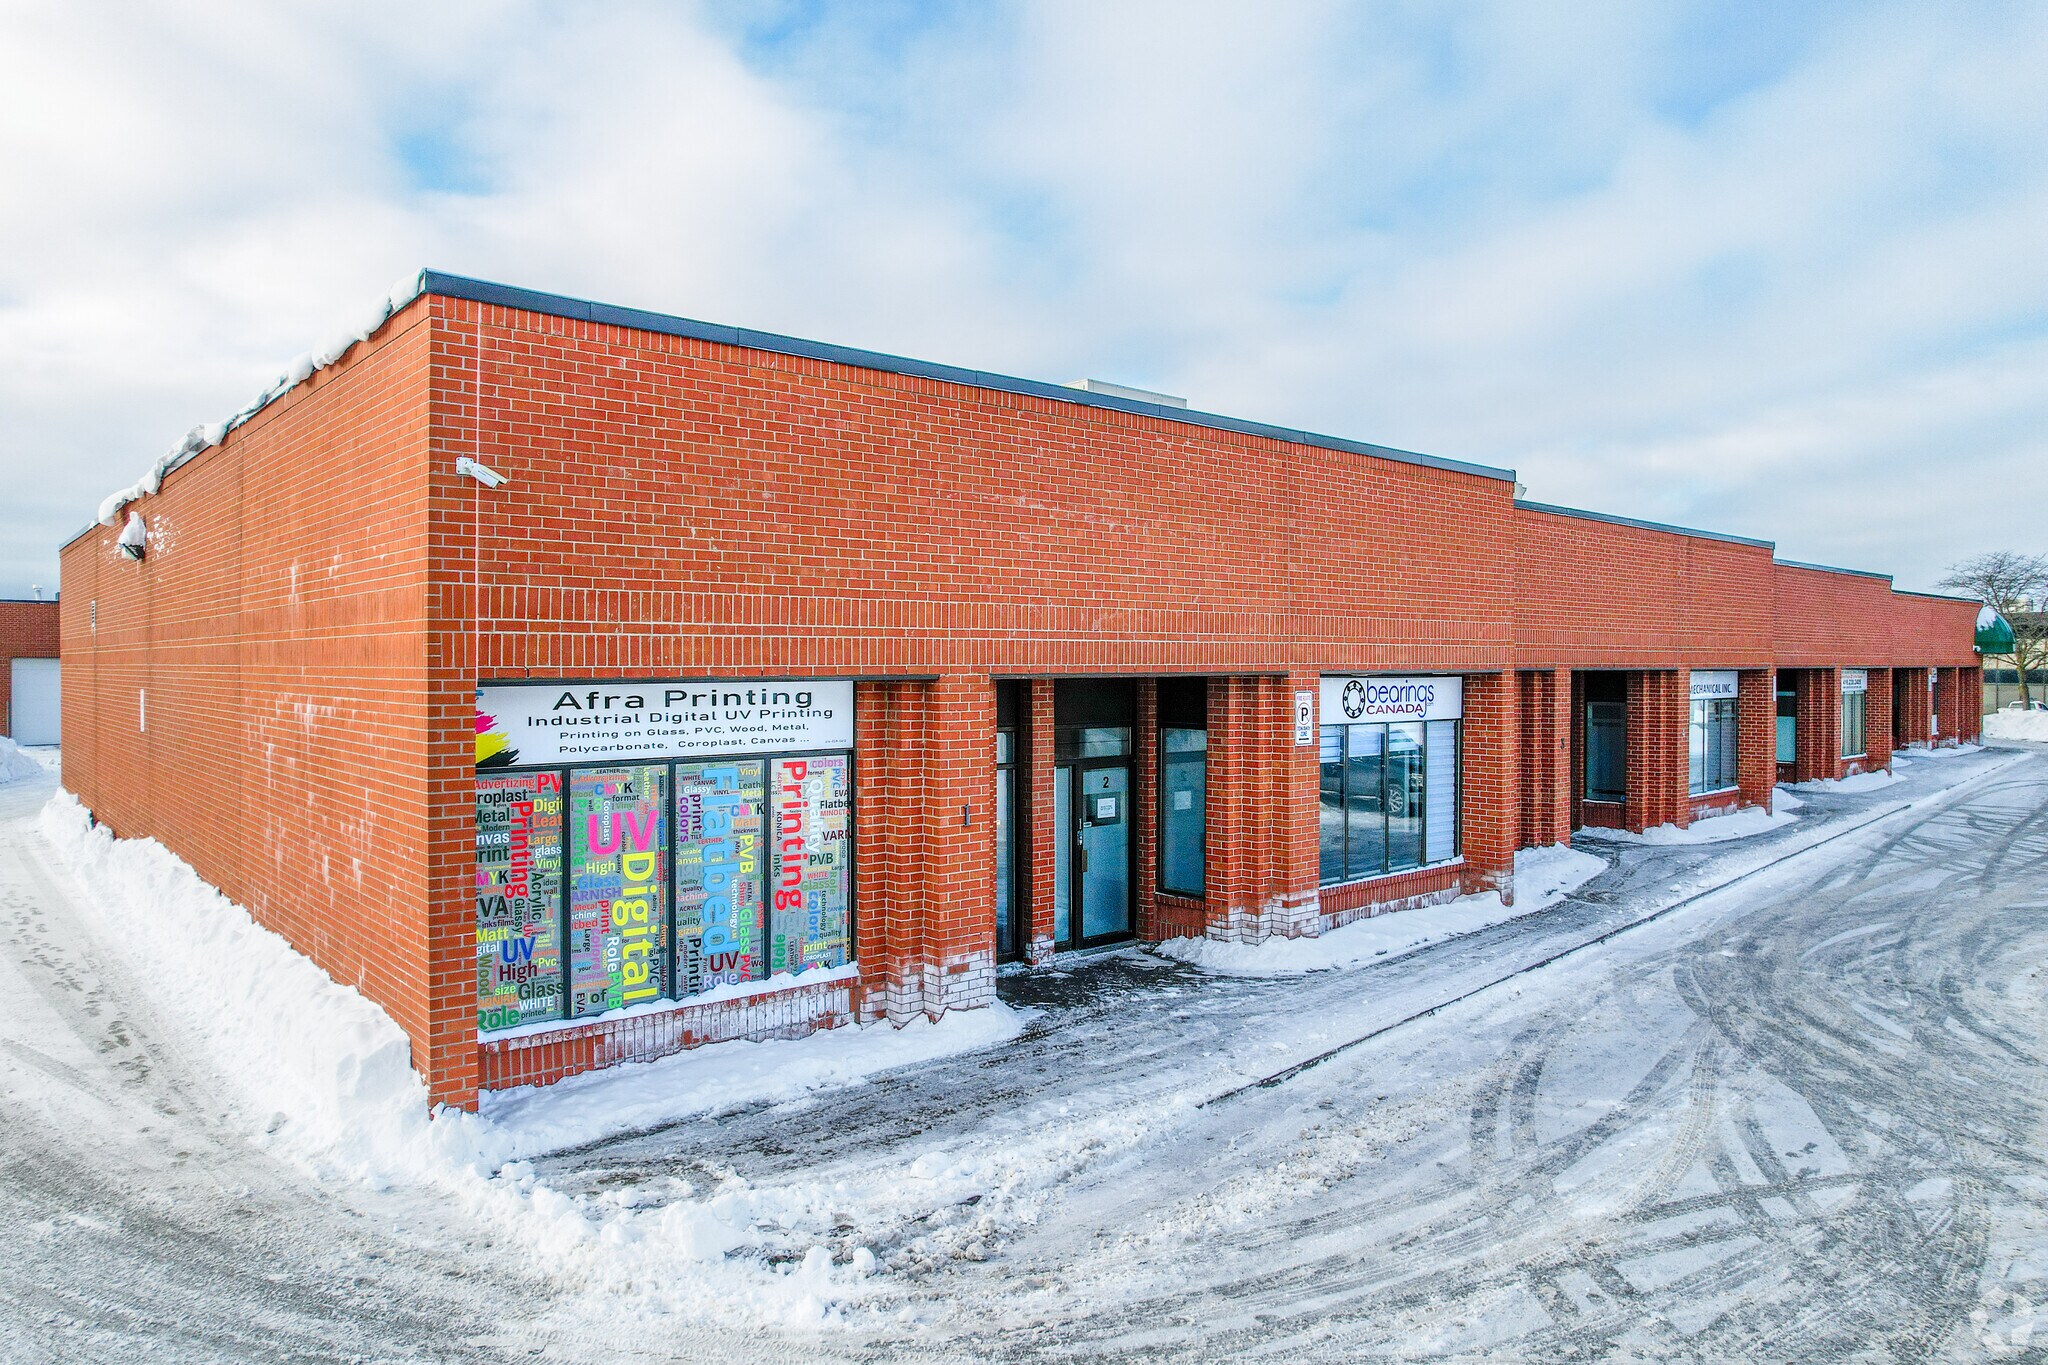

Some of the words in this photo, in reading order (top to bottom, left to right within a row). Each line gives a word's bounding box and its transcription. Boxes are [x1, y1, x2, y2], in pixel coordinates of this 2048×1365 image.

[553, 691, 644, 710] Afra
[665, 689, 812, 708] Printing
[1366, 679, 1434, 718] bearings
[528, 713, 640, 726] Industrial
[650, 711, 717, 724] Digital
[725, 710, 751, 720] UV
[759, 708, 833, 719] Printing
[1366, 704, 1423, 715] CANADA
[560, 730, 619, 739] Printing
[647, 728, 689, 736] Glass,
[730, 725, 767, 733] Wood,
[772, 723, 809, 731] Metal,
[559, 742, 668, 753] Polycarbonate,
[678, 738, 746, 748] Coroplast,
[751, 736, 796, 745] Canvas
[740, 768, 760, 776] Vinyl
[811, 758, 844, 768] colors
[594, 782, 633, 795] CMYK
[832, 768, 841, 789] PVC
[1103, 776, 1109, 788] 2
[612, 794, 640, 802] format
[684, 785, 711, 795] Glassy
[680, 797, 691, 842] colors
[690, 794, 704, 831] print
[731, 803, 764, 817] CMYK
[805, 779, 824, 853] Quality
[602, 801, 611, 841] Coroplast
[527, 834, 558, 846] Large
[588, 810, 659, 855] UV
[775, 761, 809, 911] Printing
[504, 802, 535, 898] Printing
[739, 834, 754, 874] PVB
[809, 853, 833, 866] PVB
[535, 857, 561, 871] Vinyl
[585, 860, 615, 875] High
[702, 768, 740, 956] Flatbed
[773, 854, 782, 877] inks
[543, 878, 557, 886] idea
[543, 887, 557, 895] wall
[801, 880, 830, 891] Glass
[529, 872, 545, 920] Acrylic
[730, 879, 739, 929] technology
[481, 920, 497, 928] inks
[512, 898, 525, 933] Glassy
[598, 900, 612, 934] print
[612, 852, 658, 1000] Digital
[808, 891, 821, 941] colors
[476, 927, 509, 943] Matt
[739, 908, 752, 955] Glass
[819, 930, 842, 939] quality
[502, 936, 536, 963] UV
[607, 936, 620, 972] Role
[772, 933, 786, 969] Role
[803, 941, 828, 954] print
[500, 960, 538, 983] High
[649, 959, 659, 984] PVC
[710, 951, 739, 972] UV
[740, 955, 751, 983] PVC
[478, 954, 493, 997] Wood
[703, 971, 738, 989] Role
[494, 985, 516, 995] size
[591, 988, 607, 1003] of
[608, 972, 622, 1009] PVB
[519, 996, 554, 1011] WHITE
[521, 1008, 547, 1020] printed
[577, 993, 585, 1014] EVA
